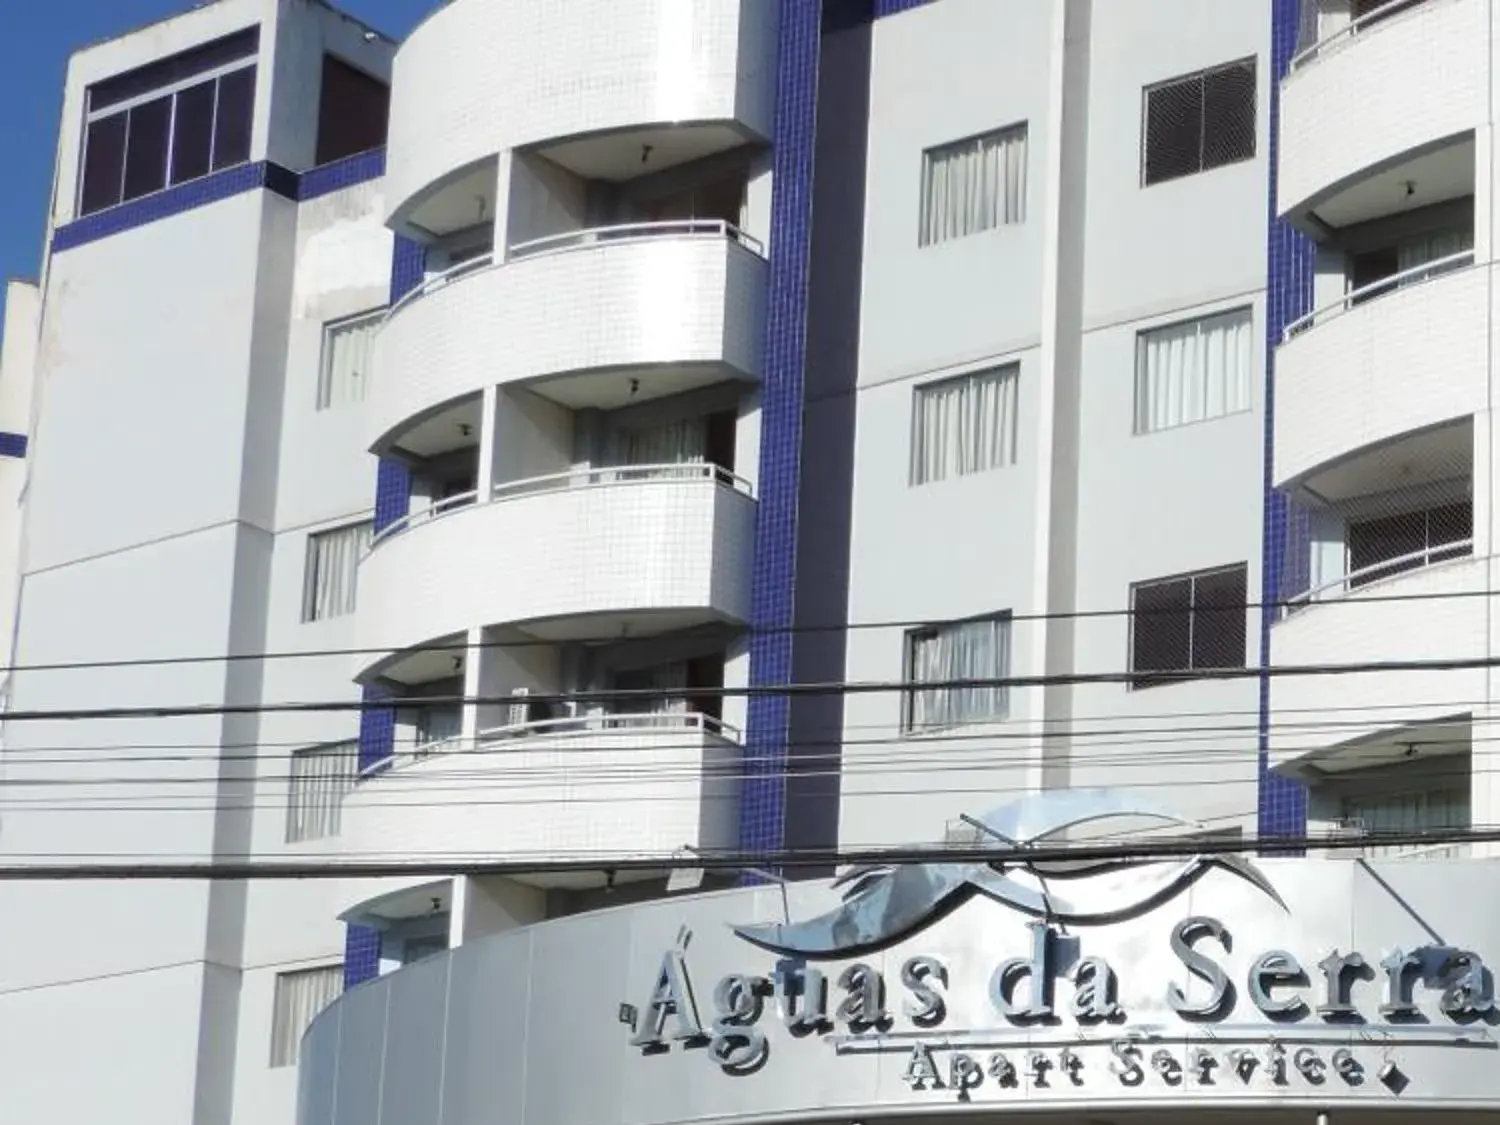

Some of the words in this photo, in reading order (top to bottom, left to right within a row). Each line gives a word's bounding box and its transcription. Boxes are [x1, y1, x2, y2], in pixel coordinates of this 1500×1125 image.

[629, 922, 948, 1077] Águas
[989, 920, 1128, 1029] da
[902, 1040, 1083, 1103] Apart
[1111, 1037, 1366, 1088] Service
